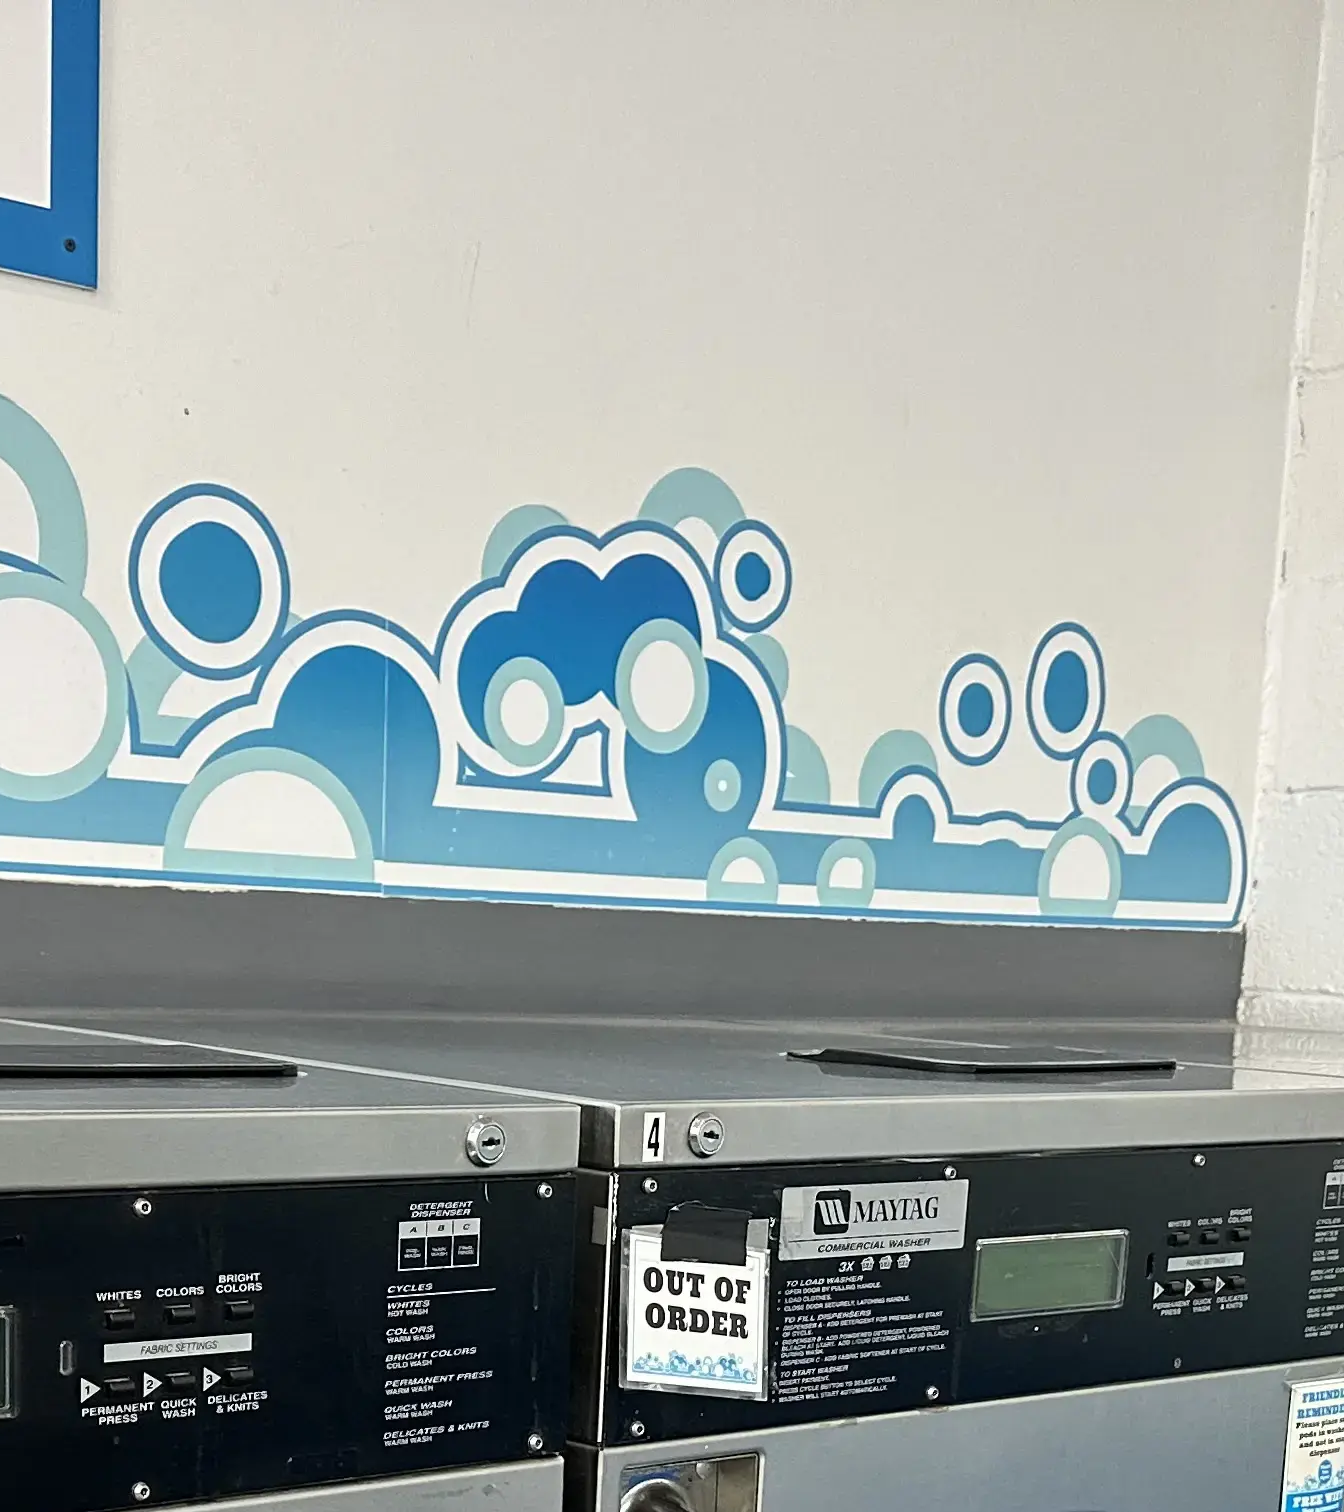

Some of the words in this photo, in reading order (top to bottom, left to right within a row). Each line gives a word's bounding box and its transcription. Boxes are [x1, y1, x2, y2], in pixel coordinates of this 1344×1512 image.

[648, 1117, 660, 1157] 4
[410, 1201, 473, 1210] DETERGENT
[853, 1197, 938, 1223] MAYTAG
[411, 1209, 471, 1218] DISPENSER
[818, 1241, 885, 1253] COMMERCIAL
[889, 1238, 931, 1248] WASHER
[838, 1261, 855, 1272] 3X
[218, 1273, 261, 1284] BRIGHT
[216, 1283, 262, 1294] COLORS
[387, 1283, 433, 1293] CYCLES
[643, 1267, 705, 1298] OUT
[714, 1276, 751, 1304] OF
[96, 1290, 142, 1301] WHITES
[156, 1286, 204, 1297] COLORS
[387, 1300, 430, 1310] WHITES
[645, 1303, 748, 1339] ORDER
[386, 1325, 434, 1336] COLORS
[140, 1344, 173, 1355] FABRIC
[175, 1340, 218, 1352] SETTINGS
[385, 1351, 429, 1362] BRIGHT
[431, 1347, 477, 1358] COLORS
[146, 1380, 154, 1389] 2
[206, 1375, 213, 1383] 3
[384, 1374, 455, 1388] PERMANENT
[457, 1370, 493, 1381] PRESS
[84, 1386, 90, 1395] 1
[161, 1398, 197, 1409] QUICK
[207, 1391, 267, 1405] DELICATES
[81, 1402, 155, 1417] PERMANENT
[216, 1405, 224, 1413] &
[227, 1401, 259, 1412] KNITS
[384, 1404, 418, 1414] QUICK
[421, 1400, 452, 1409] WASH
[99, 1413, 137, 1425] PRESS
[162, 1408, 195, 1419] WASH
[383, 1426, 445, 1440] DELICATES
[457, 1421, 490, 1431] KNITS
[1296, 1421, 1319, 1429] Please
